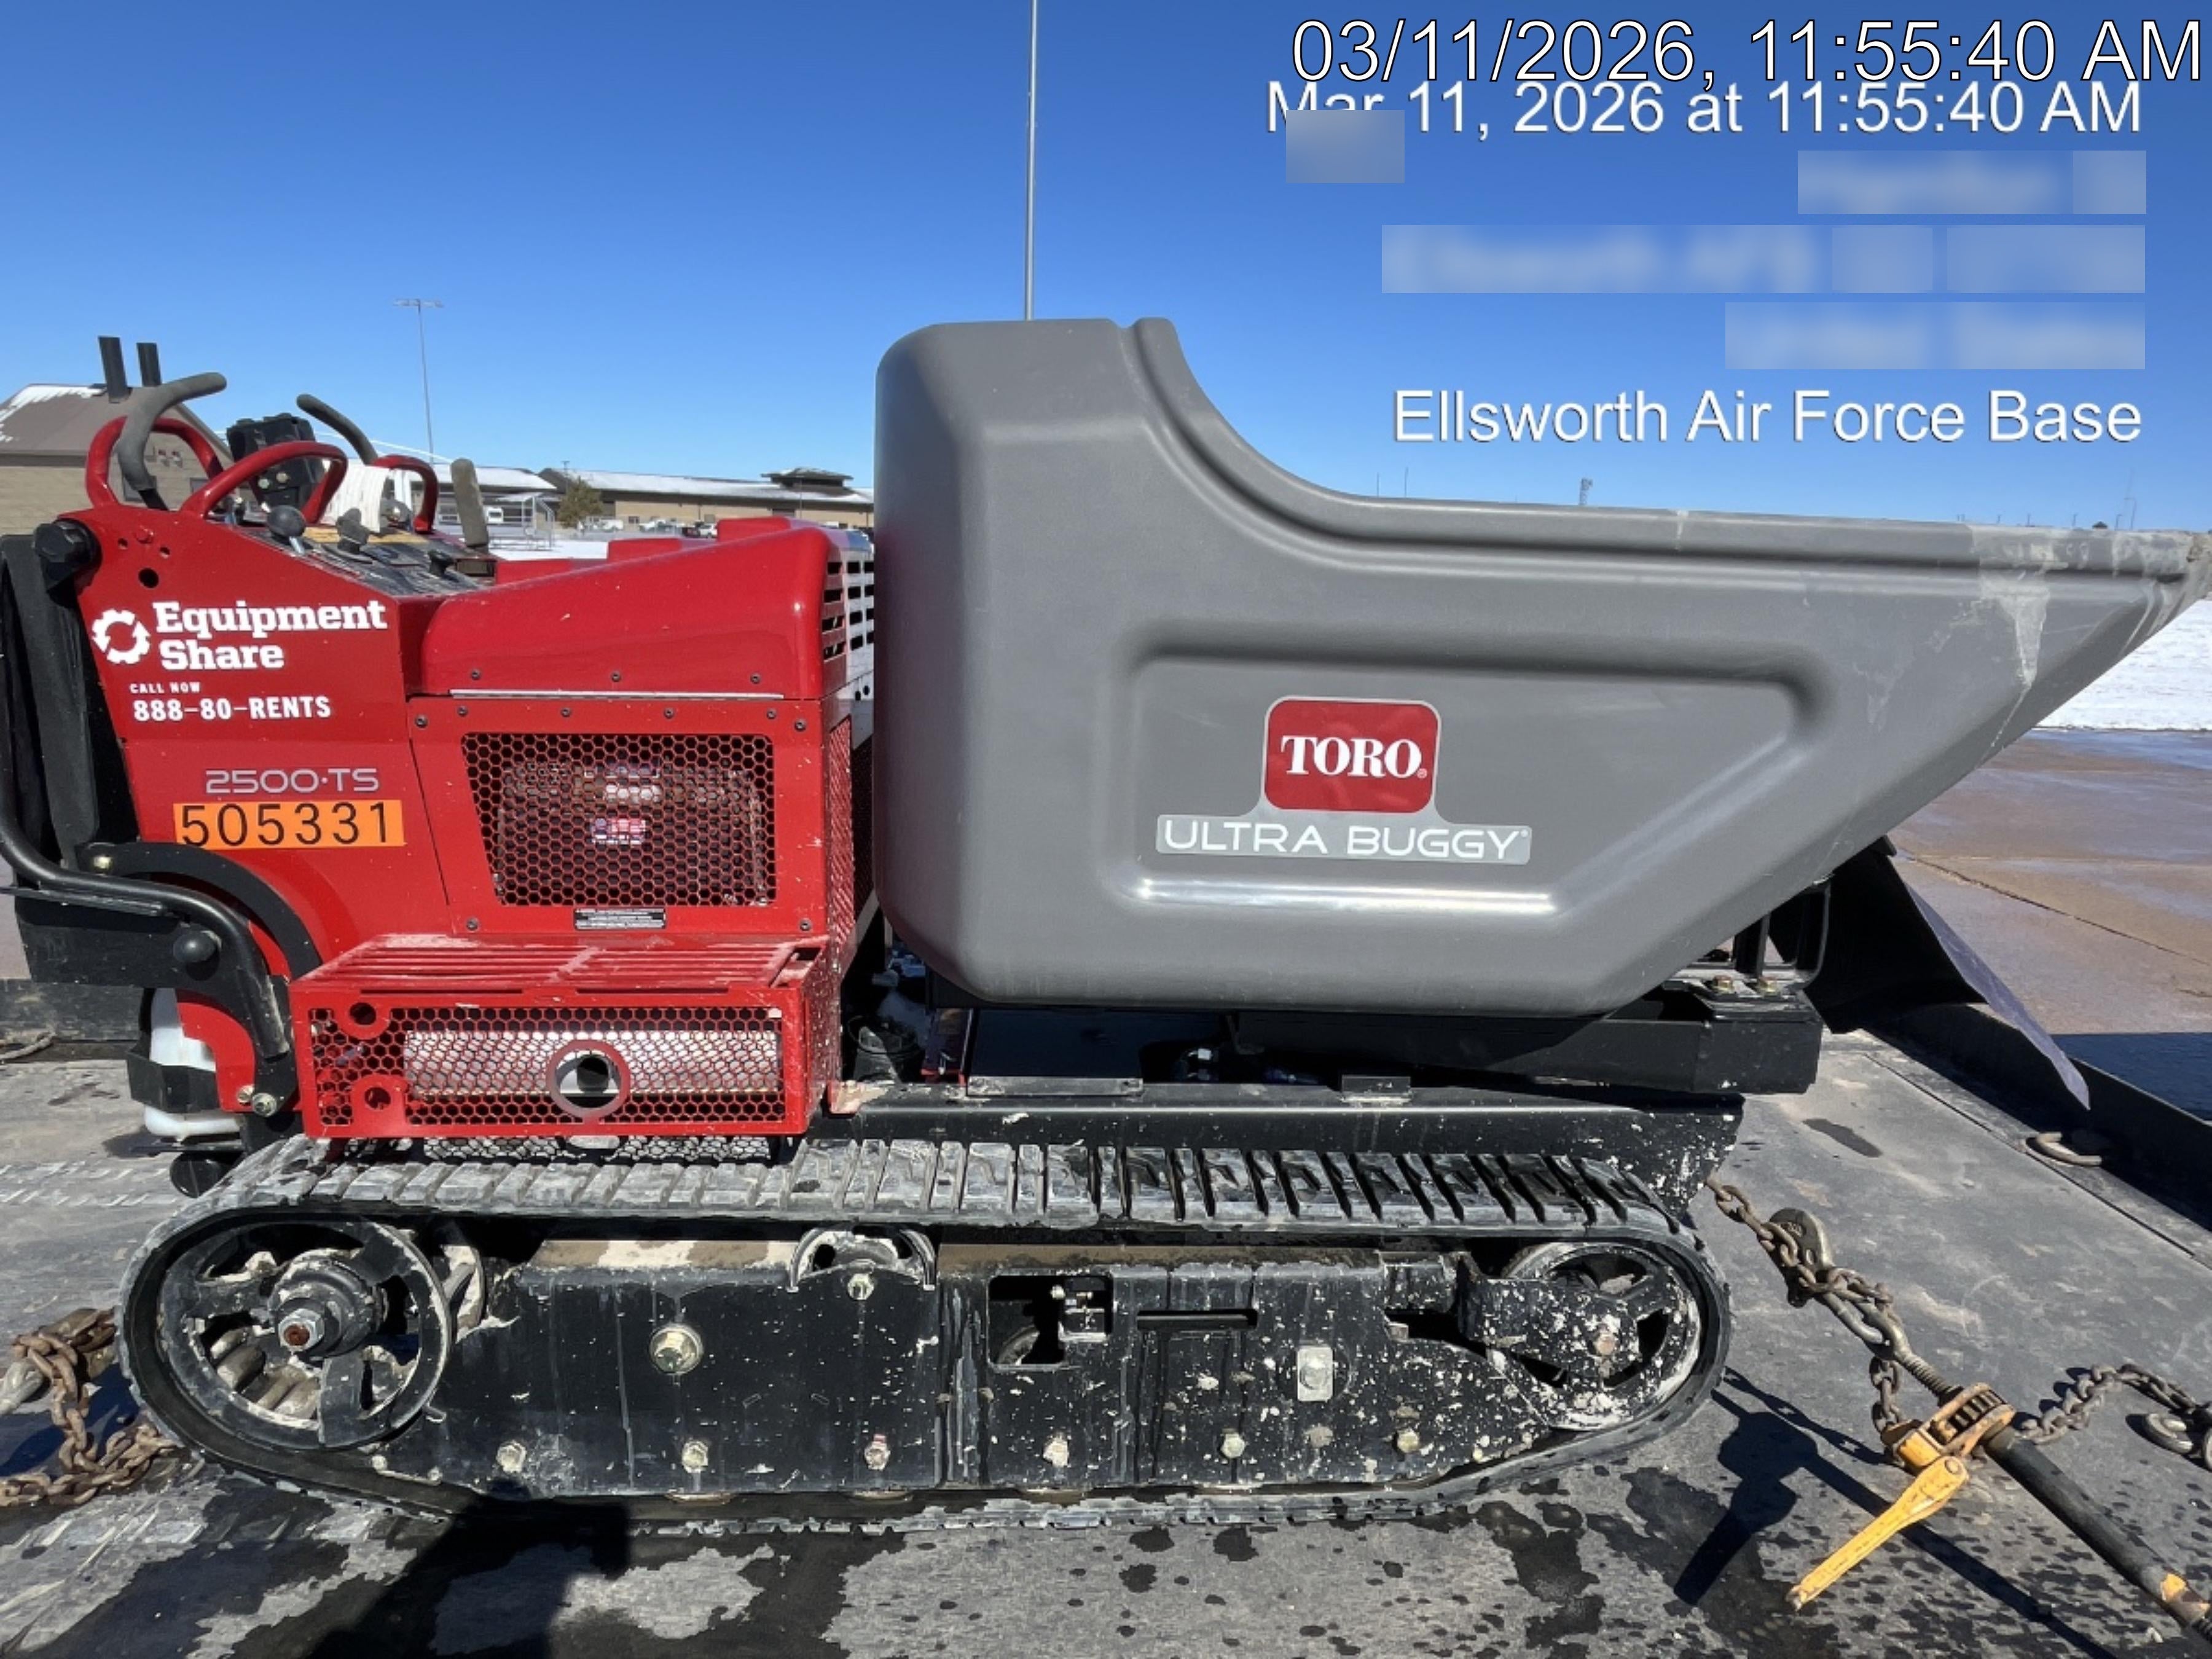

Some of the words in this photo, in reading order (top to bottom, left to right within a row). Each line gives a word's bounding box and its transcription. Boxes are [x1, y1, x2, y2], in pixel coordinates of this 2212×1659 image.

[152, 600, 388, 640] Equipment
[159, 639, 285, 670] Share
[129, 683, 165, 694] CALL
[170, 681, 200, 694] NOW
[133, 696, 332, 722] 888-80-RENTS
[181, 801, 388, 847] 505331
[1164, 819, 1328, 855] ULTRA
[1346, 825, 1521, 860] BUGGY
